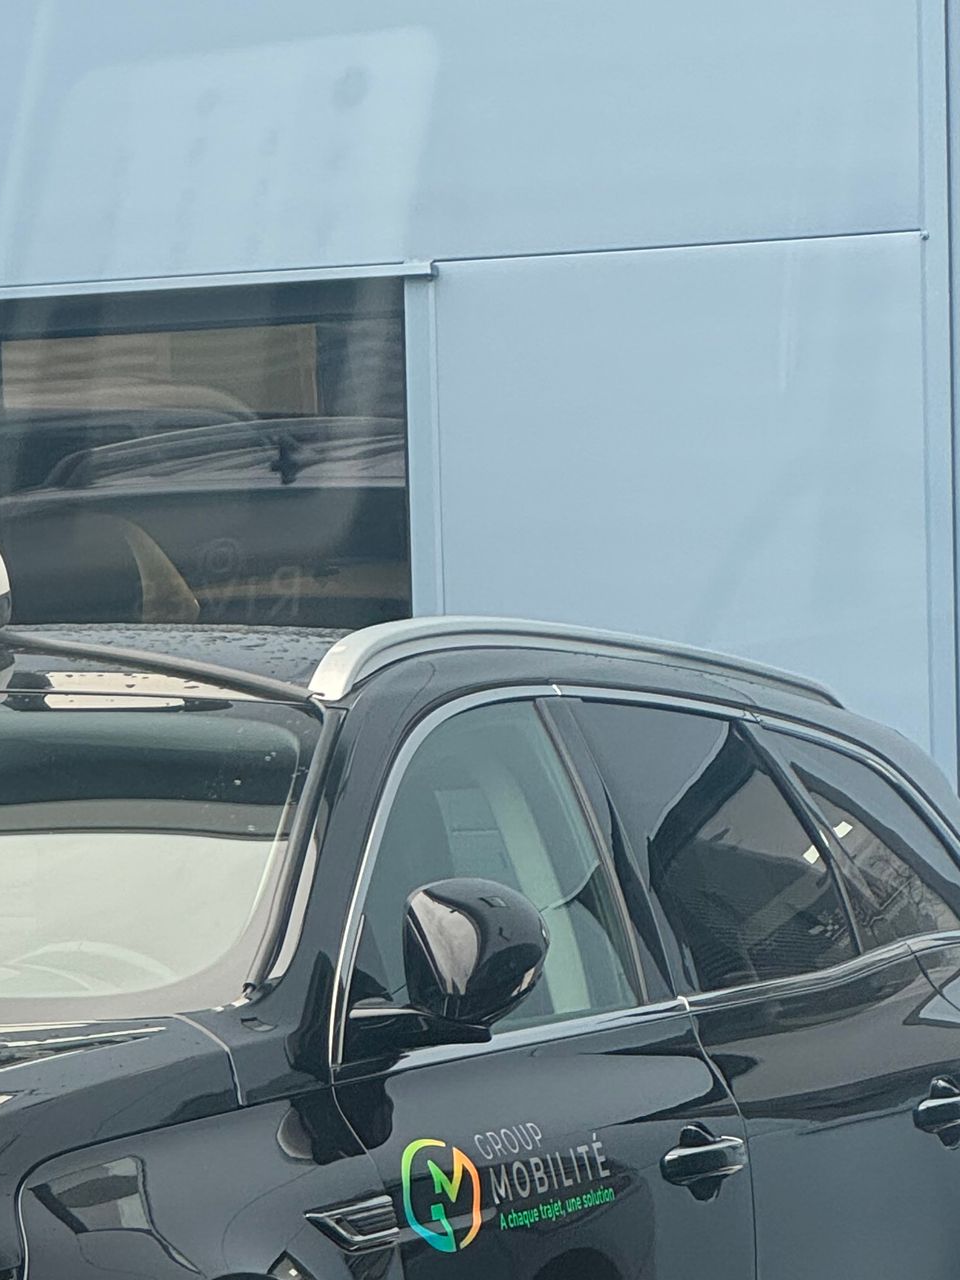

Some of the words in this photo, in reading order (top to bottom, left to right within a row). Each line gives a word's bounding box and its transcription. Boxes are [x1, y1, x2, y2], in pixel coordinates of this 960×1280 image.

[474, 1122, 542, 1160] GROUP
[489, 1132, 611, 1205] MOBILITÉ
[500, 1213, 508, 1231] A
[508, 1208, 539, 1229] chaque
[540, 1199, 567, 1221] trajet,
[566, 1196, 583, 1214] une
[583, 1185, 616, 1208] solution
